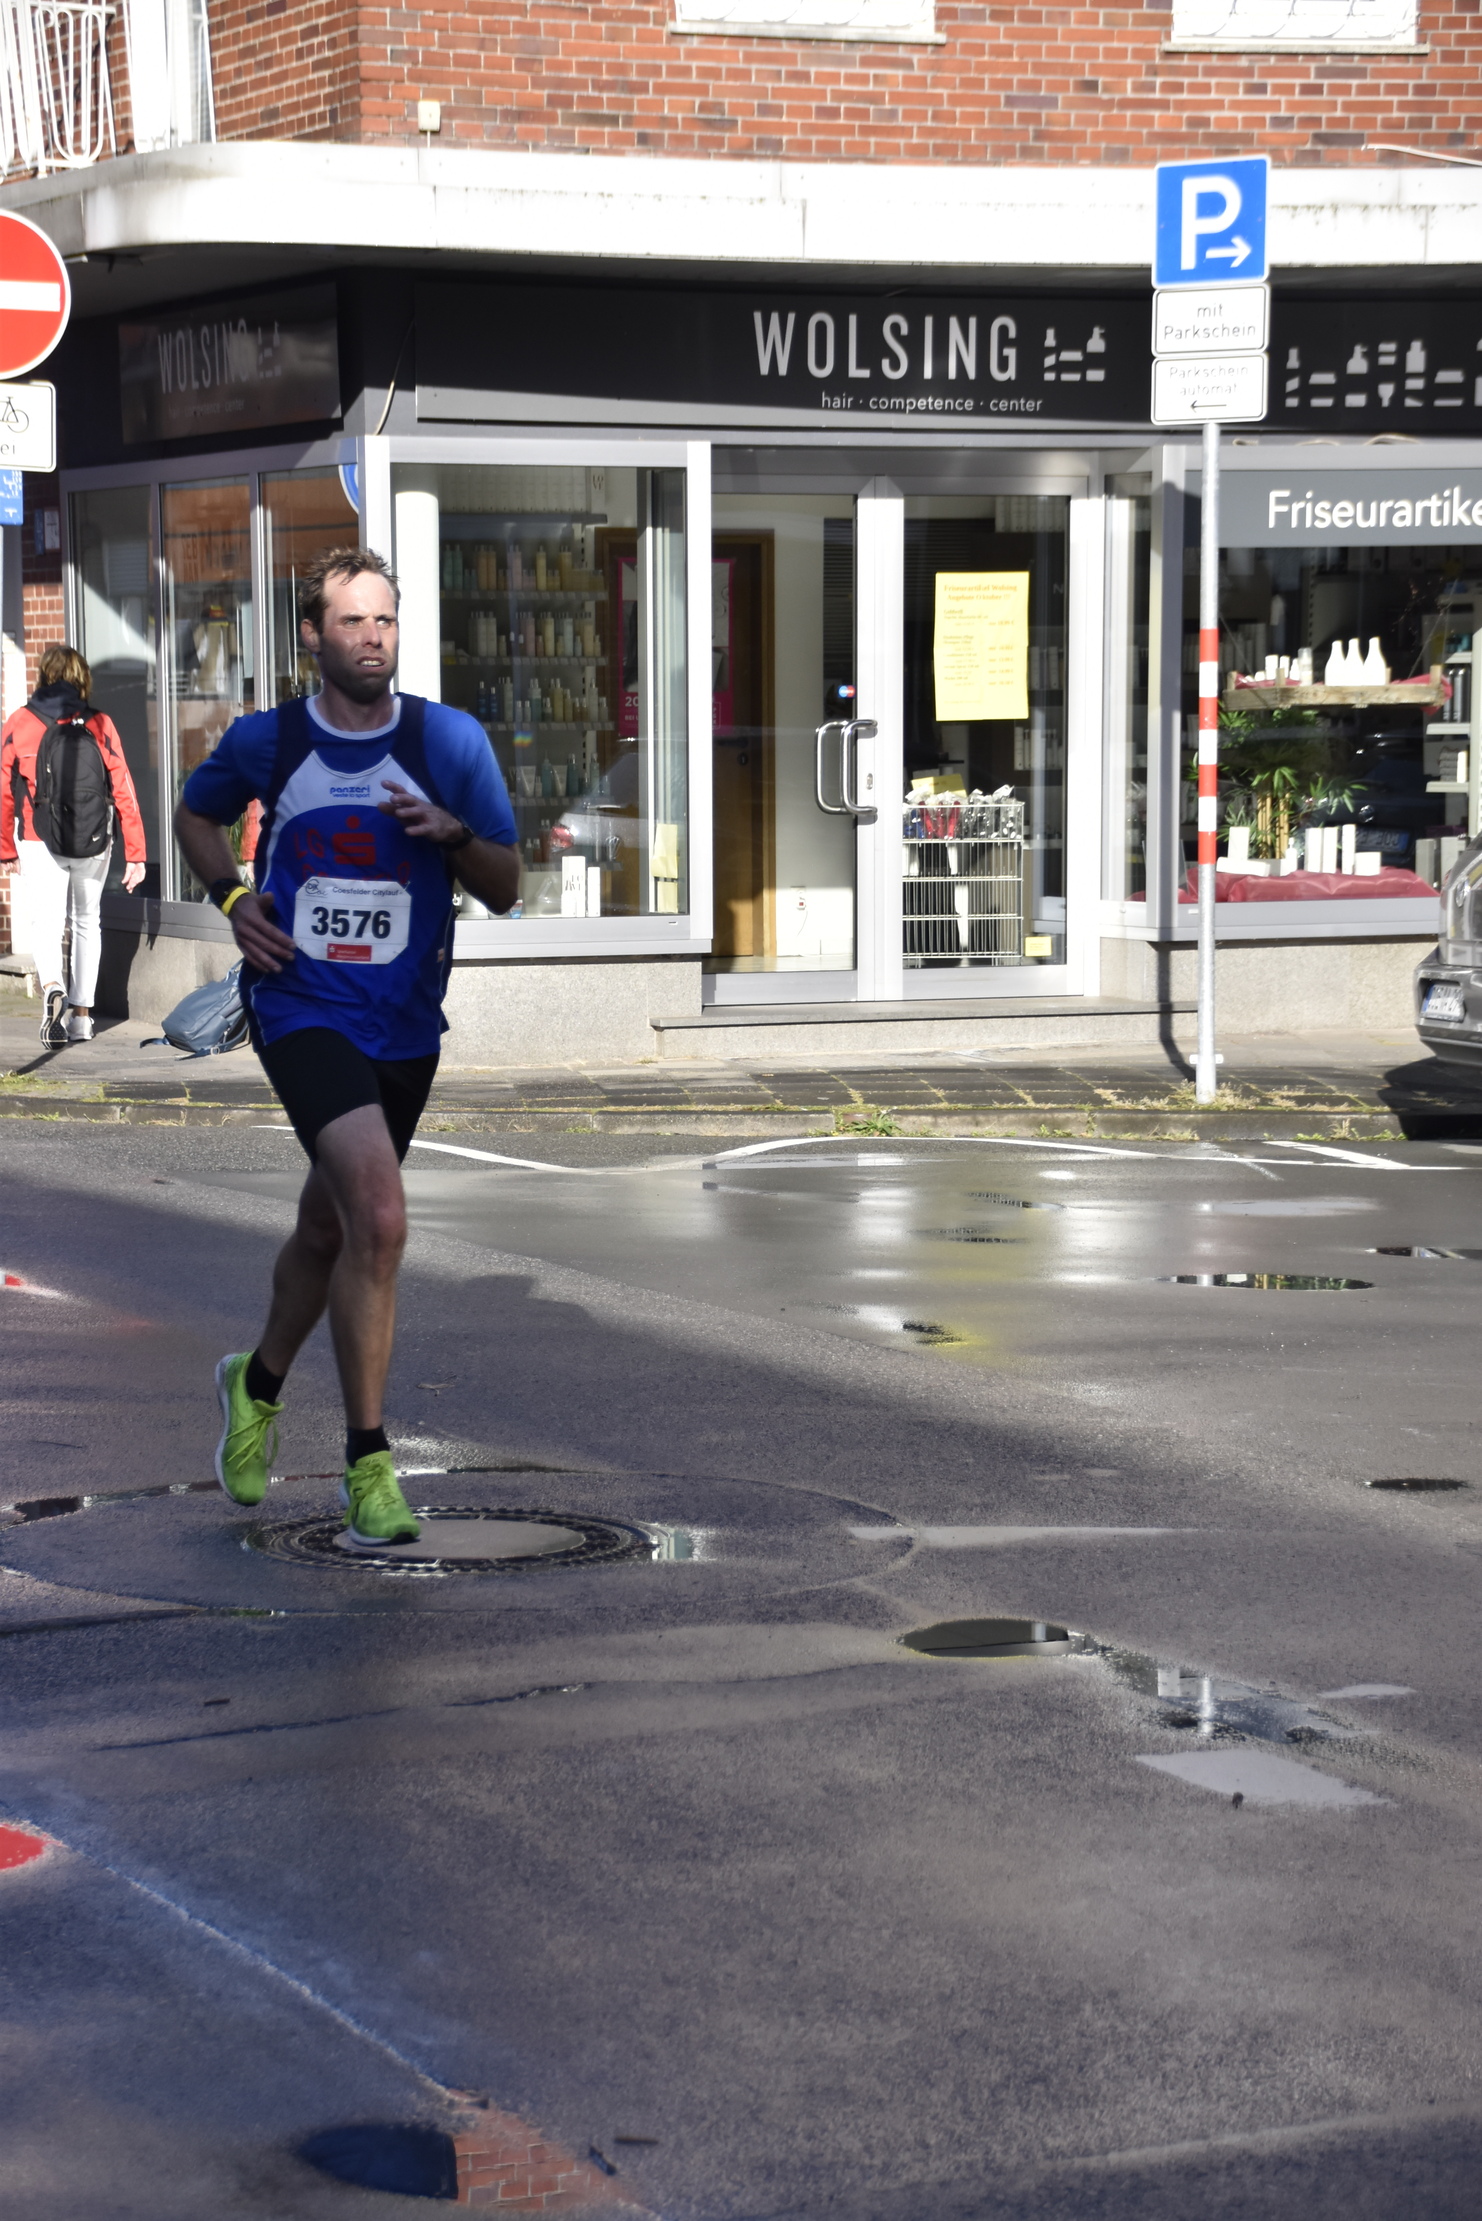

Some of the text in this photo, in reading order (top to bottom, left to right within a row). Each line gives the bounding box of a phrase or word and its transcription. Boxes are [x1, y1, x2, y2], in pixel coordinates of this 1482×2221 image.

[1181, 175, 1241, 270] P
[1196, 303, 1223, 318] mit
[1163, 323, 1256, 340] Parkschein
[753, 311, 1017, 381] WOLSING
[1169, 365, 1249, 379] Parkschein
[821, 391, 1043, 415] hair competence center
[0, 440, 15, 455] ei
[329, 785, 370, 794] panzeri
[332, 886, 371, 896] Coesfelder
[372, 888, 399, 897] Citylauf
[311, 906, 391, 939] 3576
